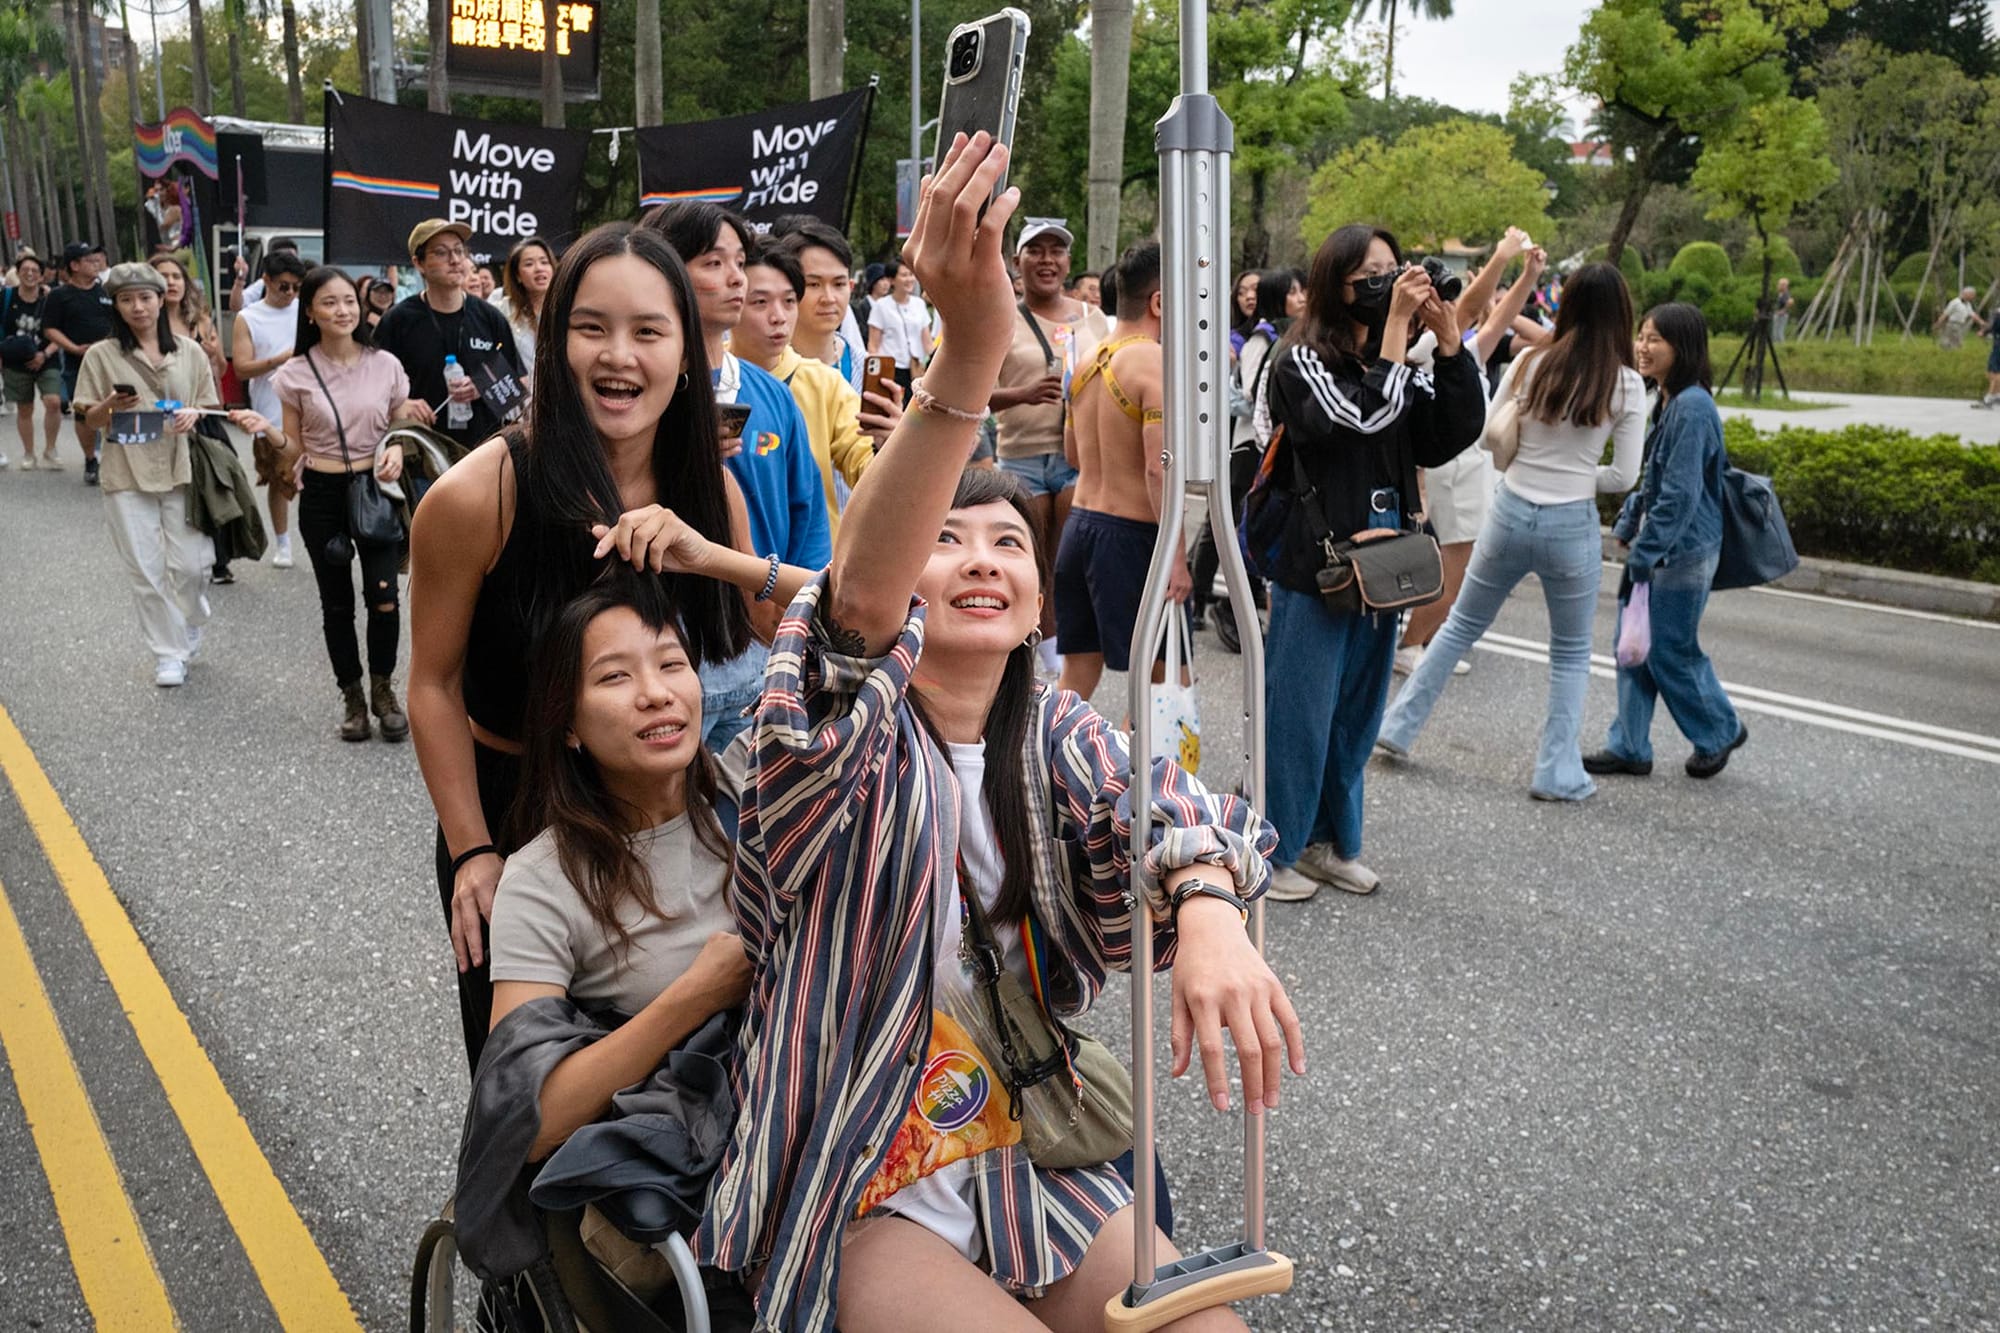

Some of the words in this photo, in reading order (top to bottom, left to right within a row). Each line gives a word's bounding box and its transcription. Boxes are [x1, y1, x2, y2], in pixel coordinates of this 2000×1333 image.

[452, 128, 555, 172] Move
[752, 119, 837, 159] Move
[449, 168, 522, 200] with
[448, 198, 538, 236] Pride
[750, 221, 773, 235] er
[470, 252, 492, 264] er
[469, 337, 493, 352] Uber
[927, 1088, 956, 1110] Hut
[929, 1073, 964, 1106] Pizza
